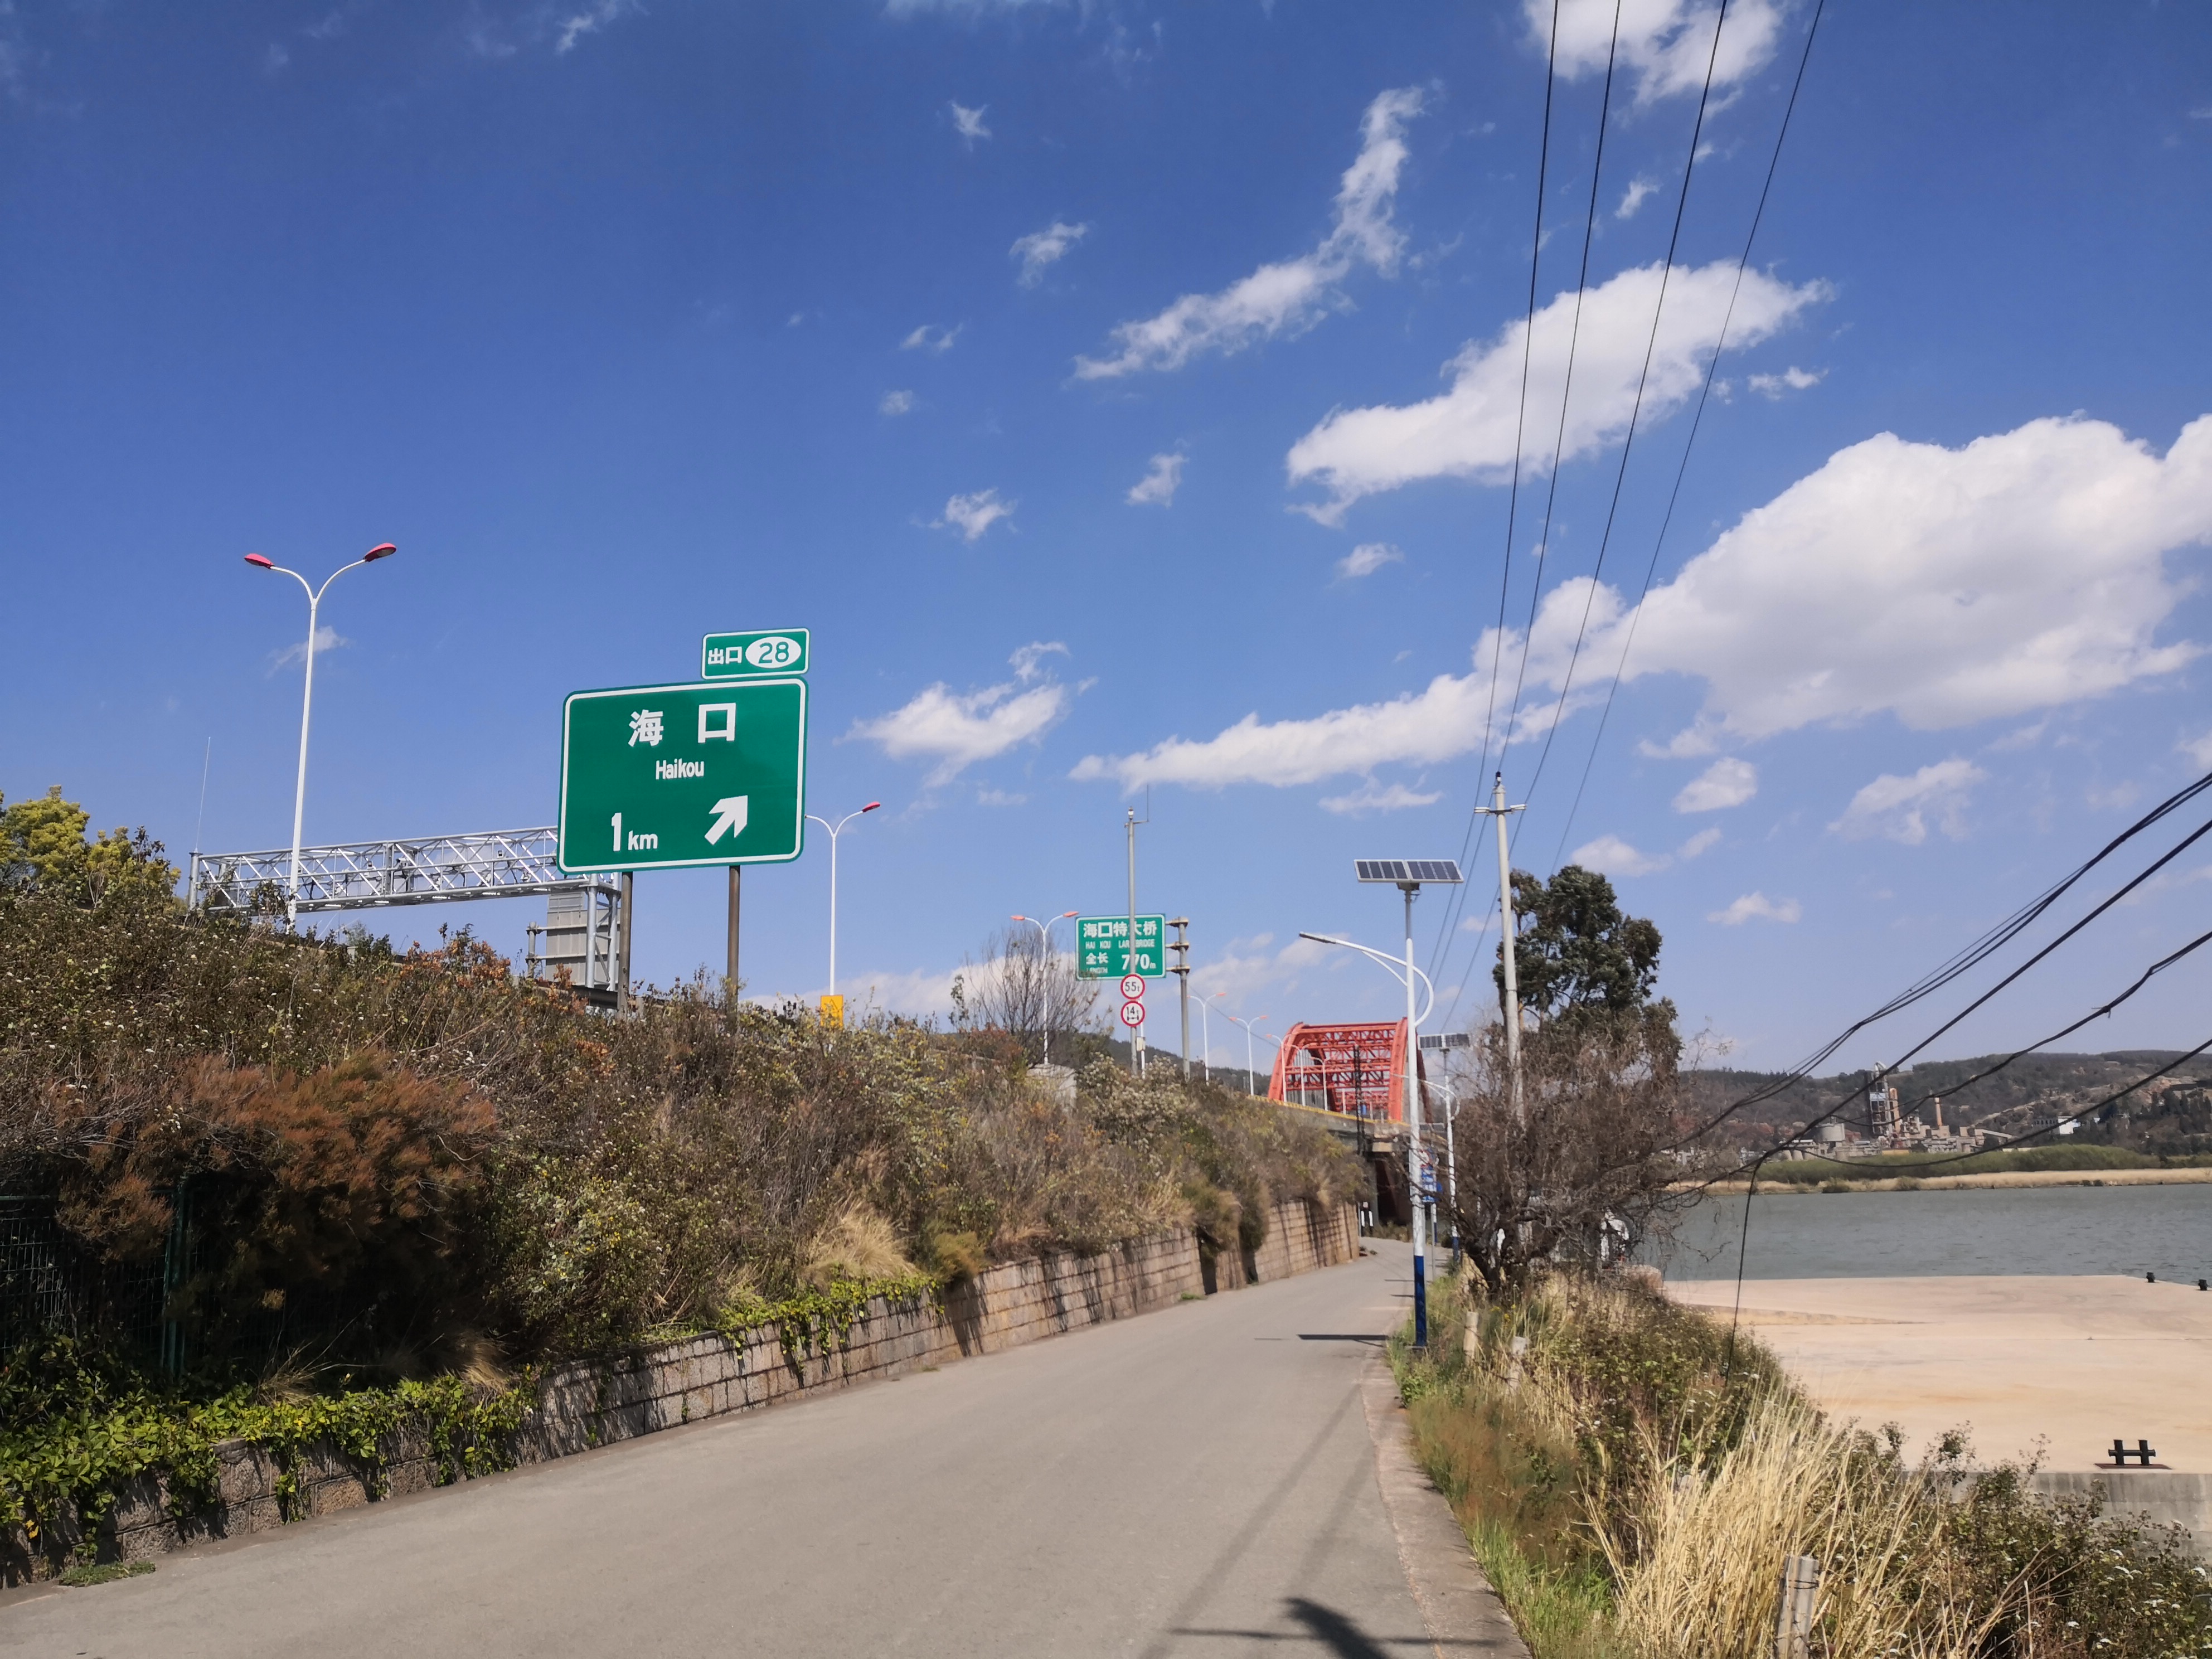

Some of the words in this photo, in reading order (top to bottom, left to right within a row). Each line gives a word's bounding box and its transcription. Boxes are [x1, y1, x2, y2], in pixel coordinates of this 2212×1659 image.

[708, 646, 743, 665] 出口
[758, 641, 789, 664] 28
[628, 702, 736, 747] 海口
[656, 758, 704, 780] Haikou
[1086, 952, 1108, 965] 全长
